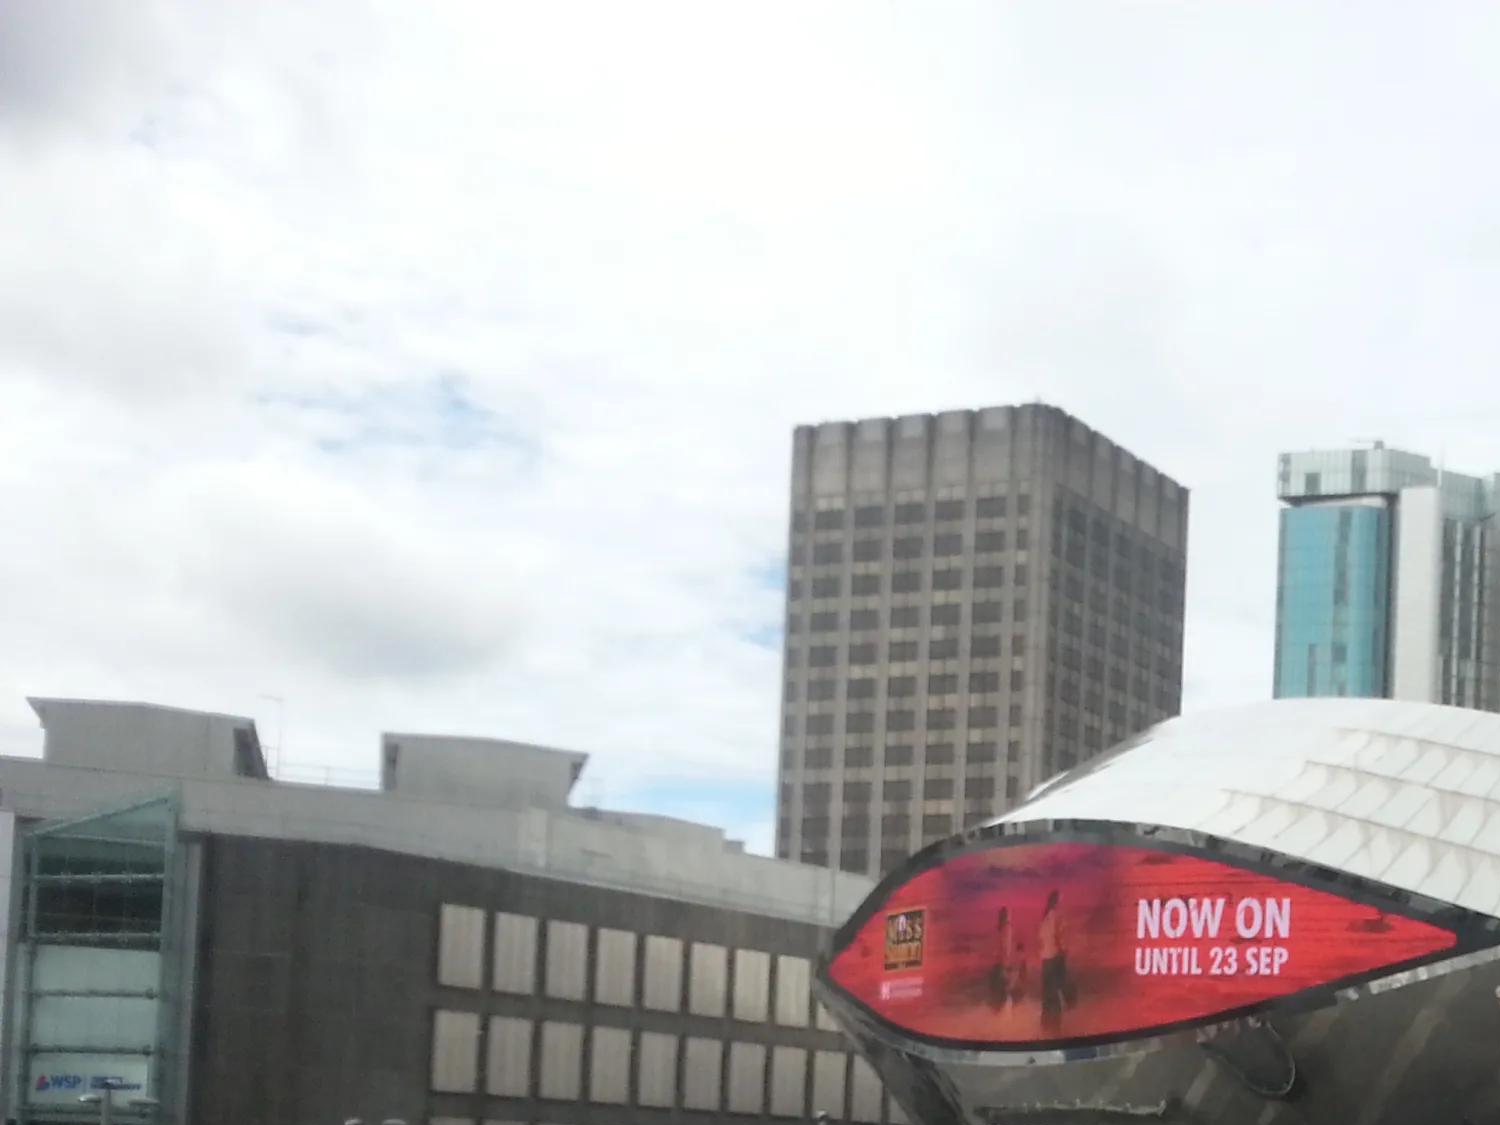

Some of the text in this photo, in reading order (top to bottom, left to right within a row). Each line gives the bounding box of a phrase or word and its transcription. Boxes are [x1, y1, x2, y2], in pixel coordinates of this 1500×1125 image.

[1136, 898, 1291, 939] NOW ON
[1135, 947, 1289, 976] UNTIL 23 SEP
